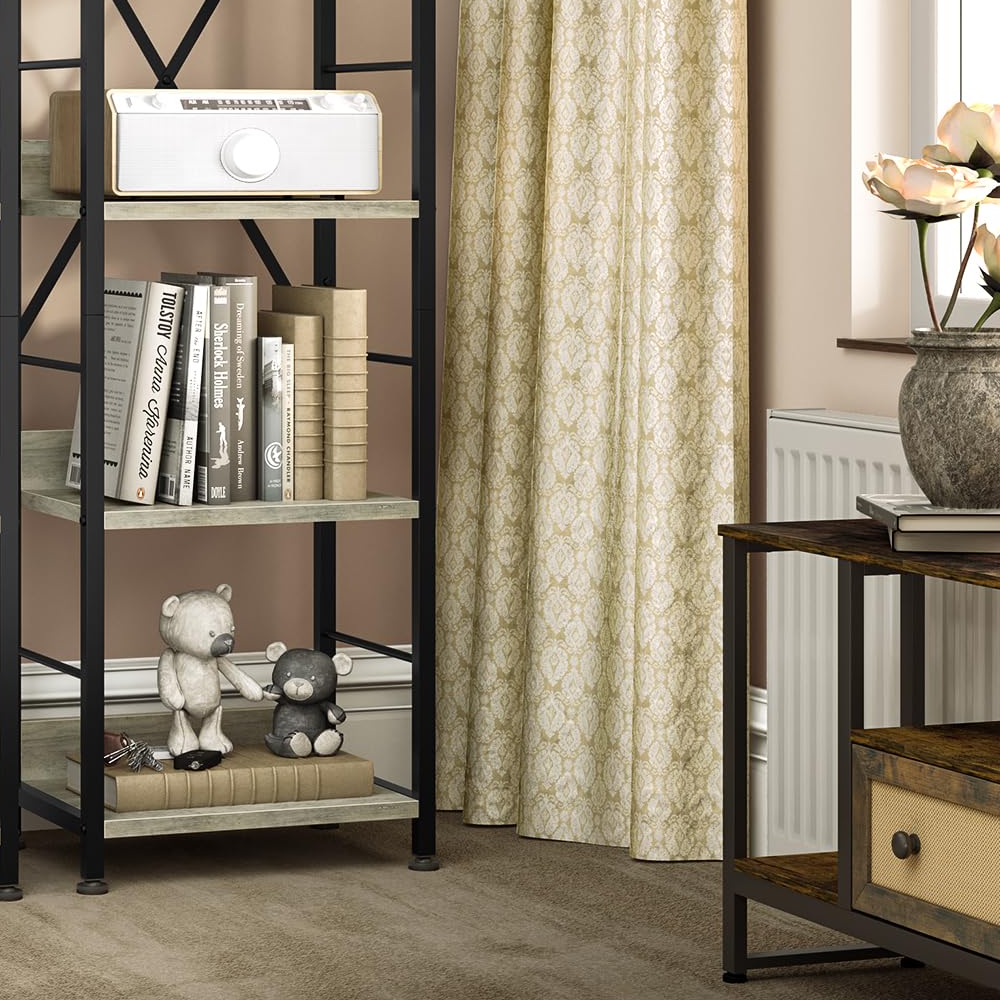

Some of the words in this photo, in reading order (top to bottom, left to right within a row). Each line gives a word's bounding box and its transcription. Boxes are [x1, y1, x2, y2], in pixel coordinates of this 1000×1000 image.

[156, 292, 177, 340] TOLSTOY
[194, 310, 203, 333] AFTER
[234, 302, 245, 347] Dreaming
[192, 348, 201, 364] END
[213, 323, 228, 368] Sherlock
[236, 348, 245, 356] of
[152, 345, 168, 394] Anna
[236, 356, 244, 389] Sweden
[213, 371, 229, 409] Holmes
[138, 398, 160, 480] Karenina
[184, 436, 194, 465] AUTHOR
[182, 468, 191, 490] NAME
